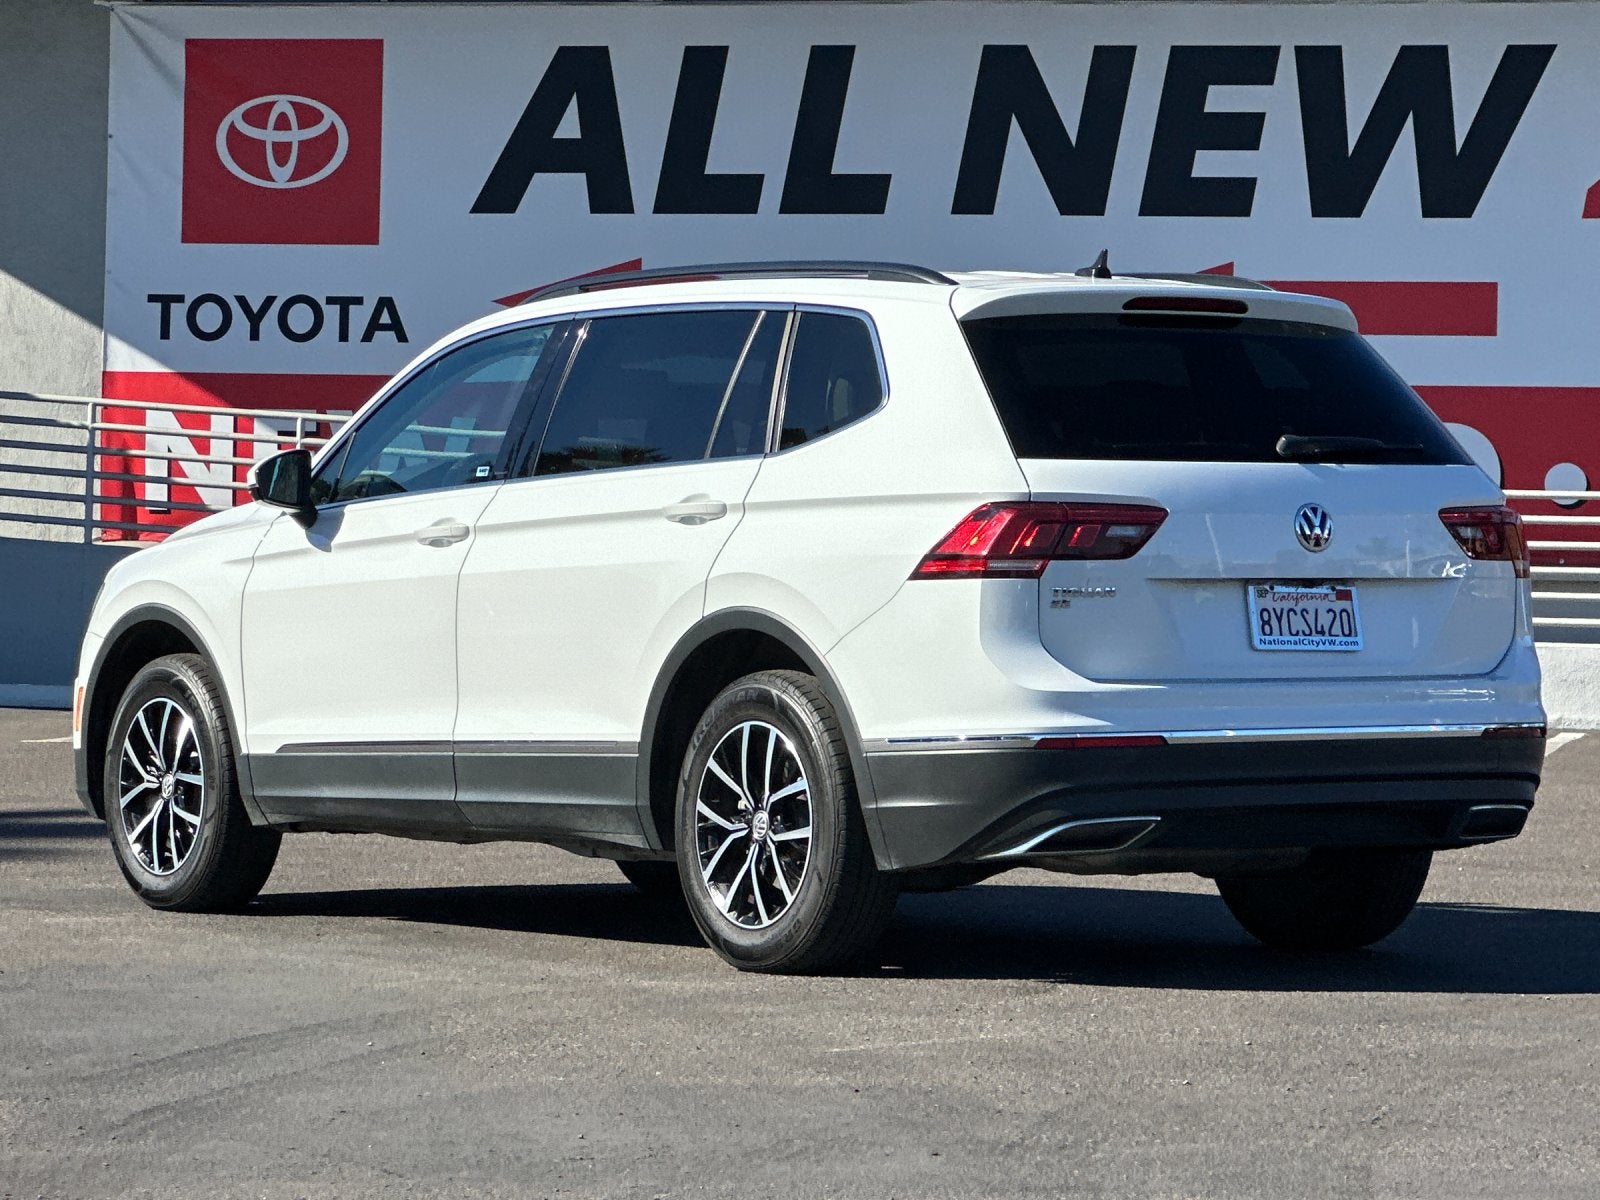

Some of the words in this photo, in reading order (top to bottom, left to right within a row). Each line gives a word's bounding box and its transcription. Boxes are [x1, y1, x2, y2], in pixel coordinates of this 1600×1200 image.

[470, 45, 891, 214] ALL
[951, 44, 1557, 218] NEW
[147, 293, 409, 343] TOYOTA
[1271, 592, 1330, 607] California
[1260, 607, 1353, 637] 8YCS420
[1259, 637, 1360, 648] NationalCityVW.com
